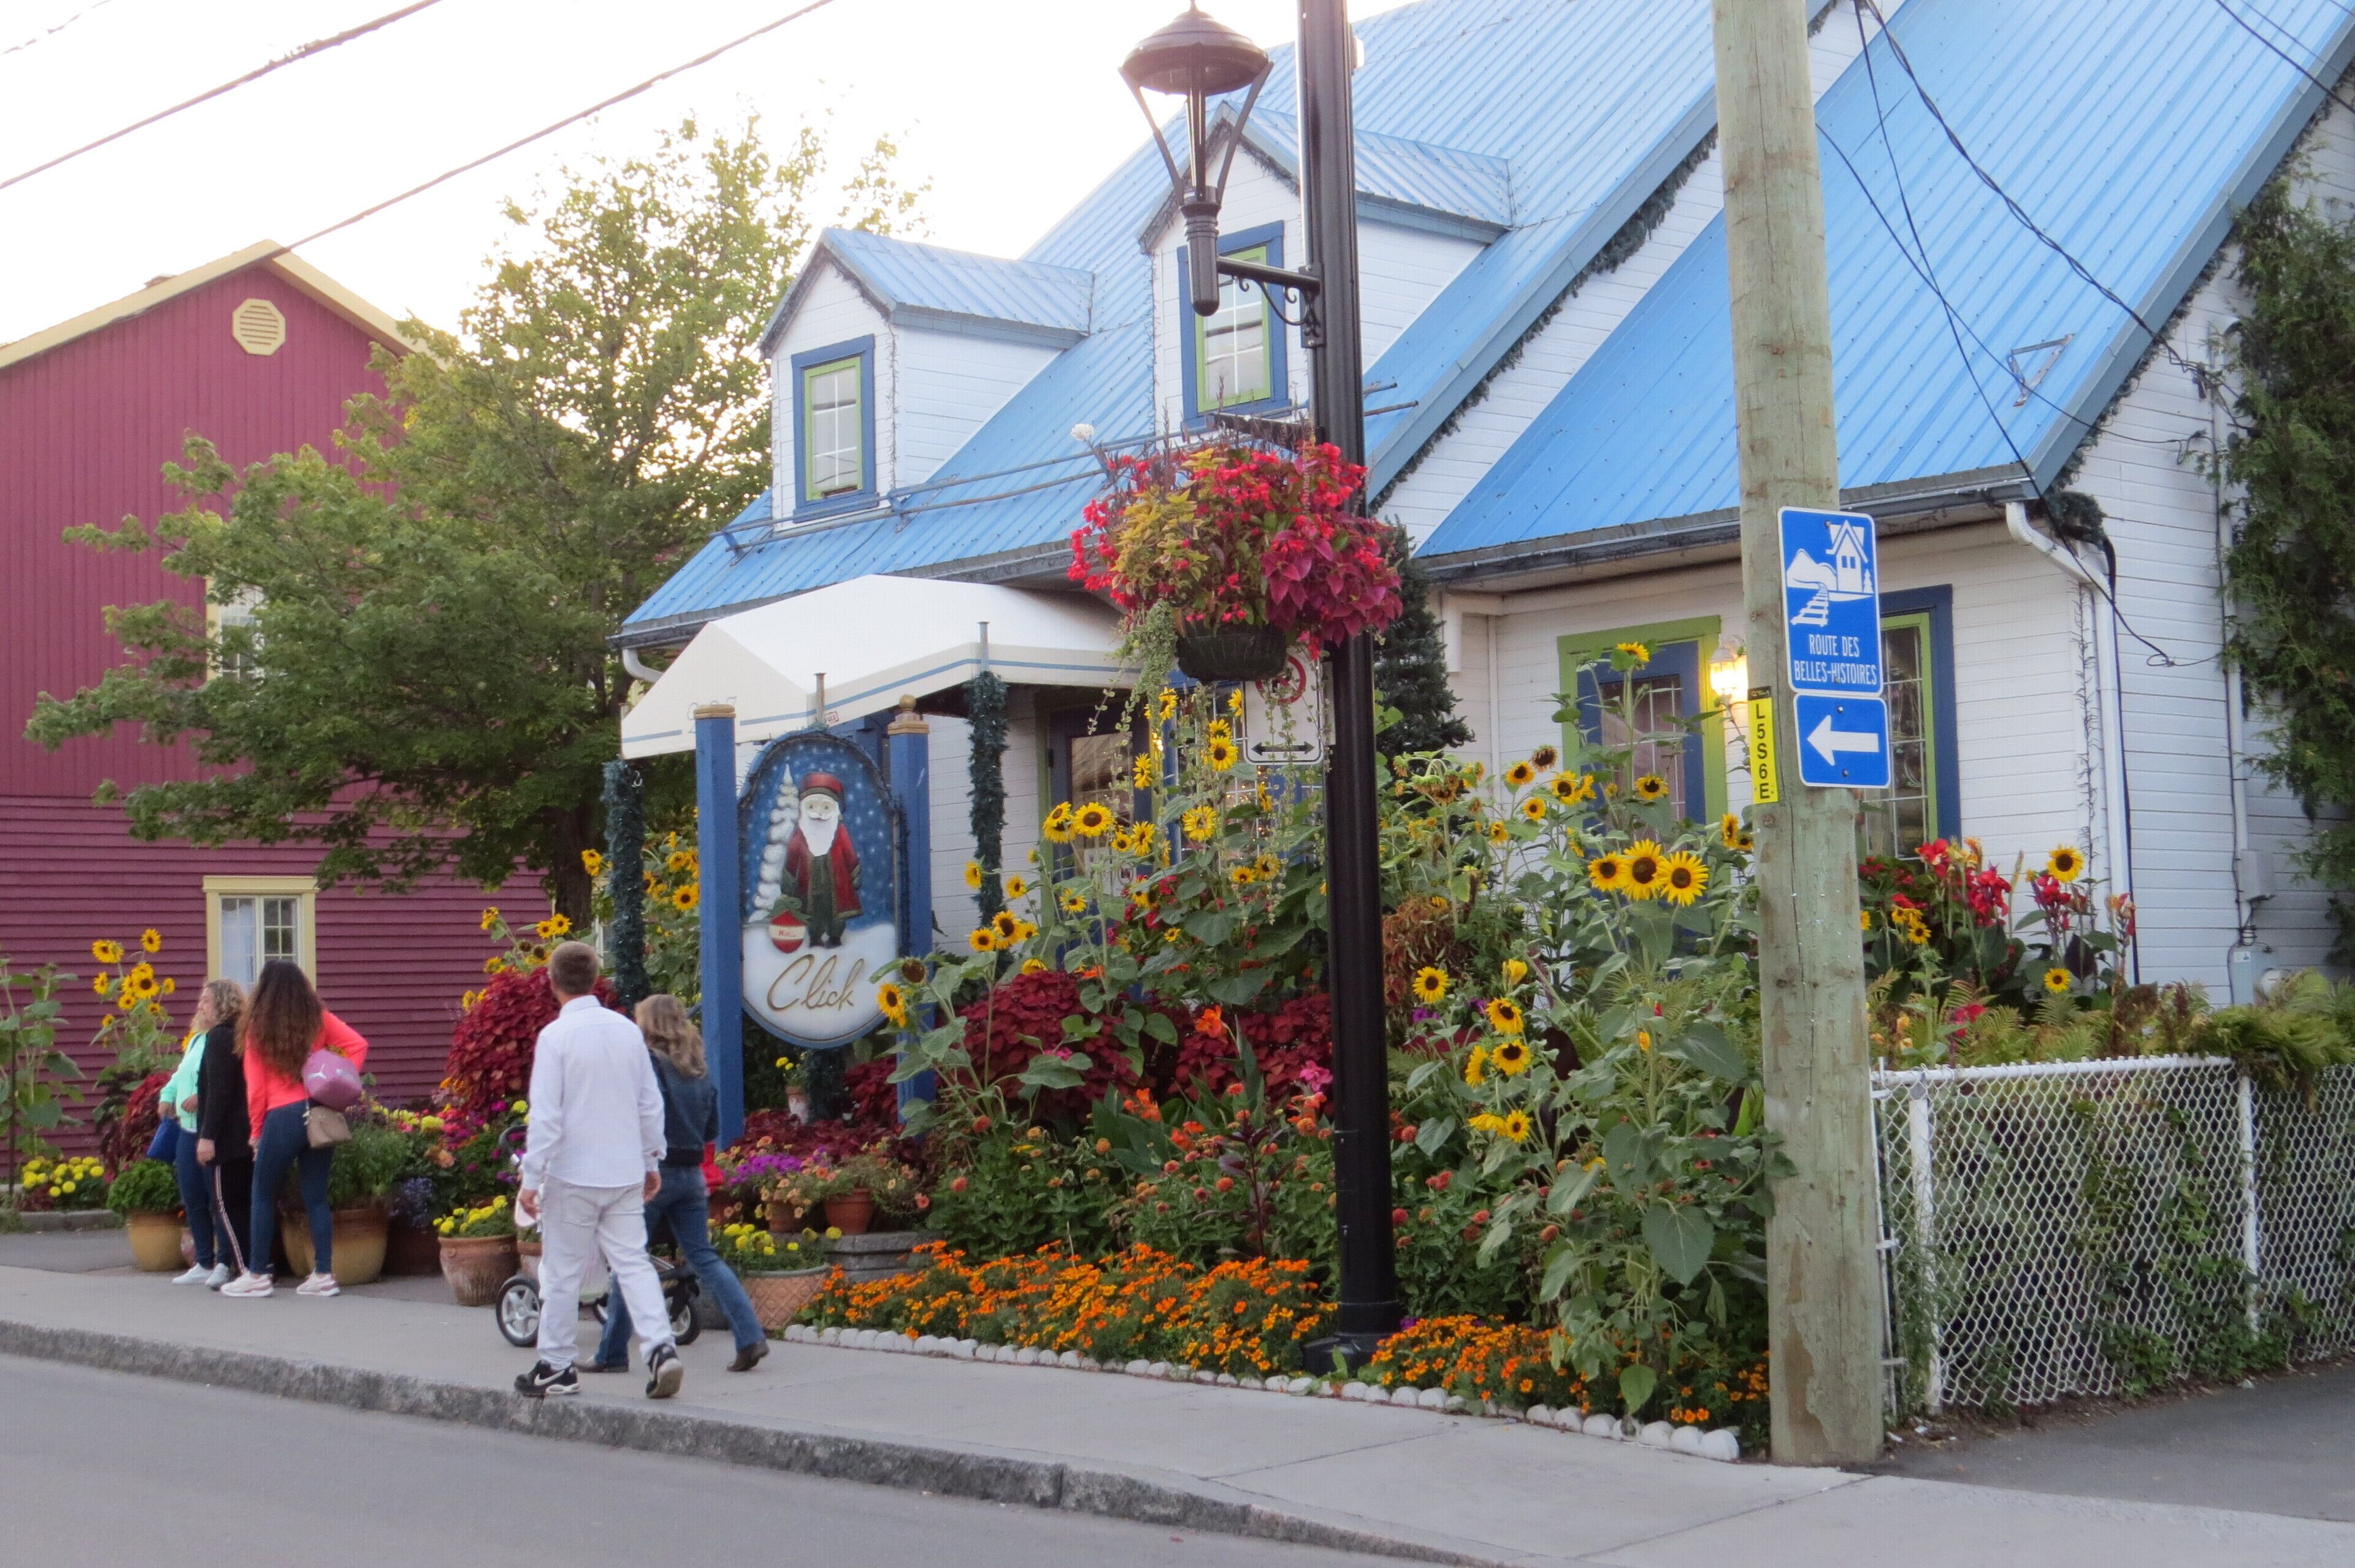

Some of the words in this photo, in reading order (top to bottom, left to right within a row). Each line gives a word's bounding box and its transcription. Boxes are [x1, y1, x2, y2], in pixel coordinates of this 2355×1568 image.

[1809, 634, 1839, 656] ROUTE
[1842, 636, 1859, 657] DES
[1794, 660, 1877, 685] BELLES-HISTOIRES
[767, 954, 864, 1011] Click
